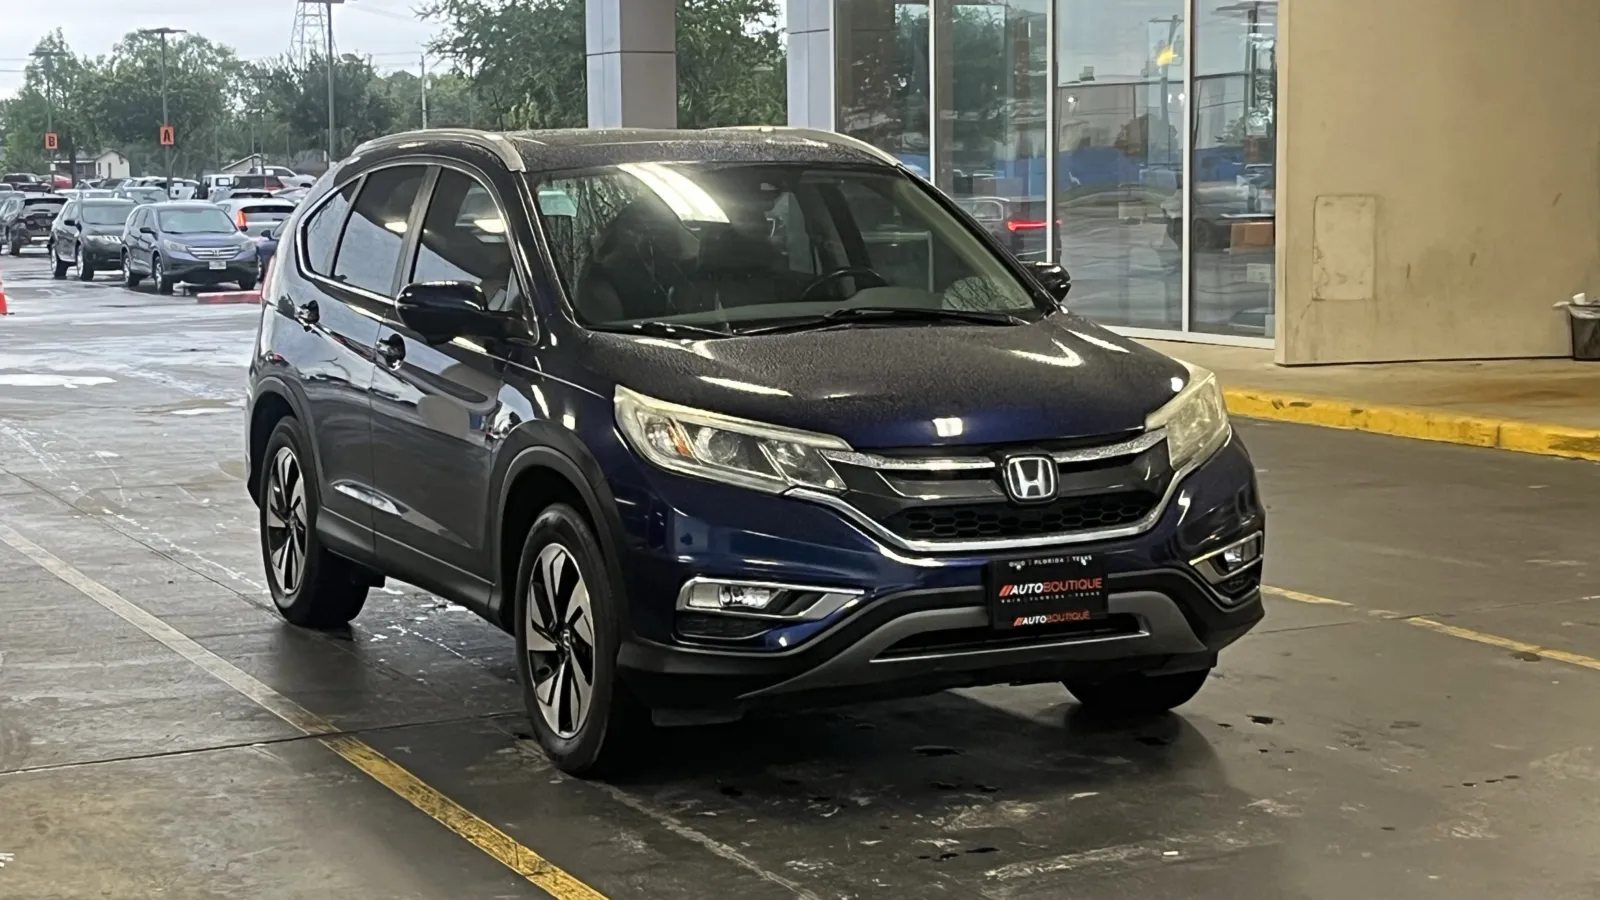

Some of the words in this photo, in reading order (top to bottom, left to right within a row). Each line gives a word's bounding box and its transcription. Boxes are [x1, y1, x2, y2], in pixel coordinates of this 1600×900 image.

[163, 129, 172, 142] A
[48, 136, 55, 147] B
[1034, 557, 1064, 565] FLORIDA
